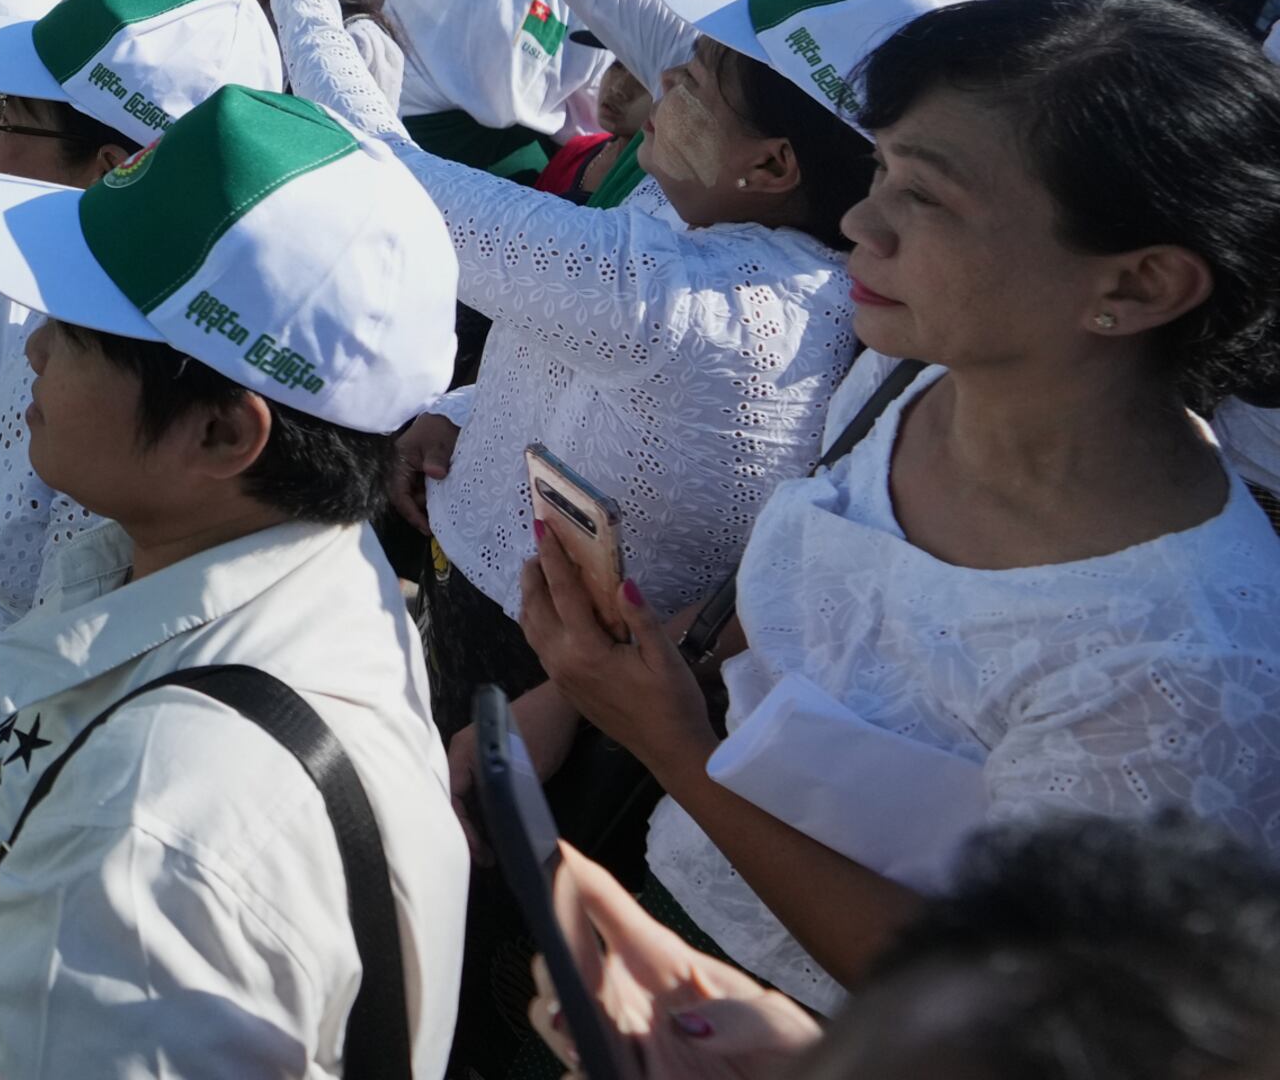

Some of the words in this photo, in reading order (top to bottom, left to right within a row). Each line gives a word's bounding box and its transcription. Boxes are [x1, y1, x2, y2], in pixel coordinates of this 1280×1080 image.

[123, 91, 174, 132] ပြည်မြန်မ
[184, 289, 251, 346] ပိုမိုခိုင်မာ
[244, 333, 324, 395] ပြည်မြန်မာ
